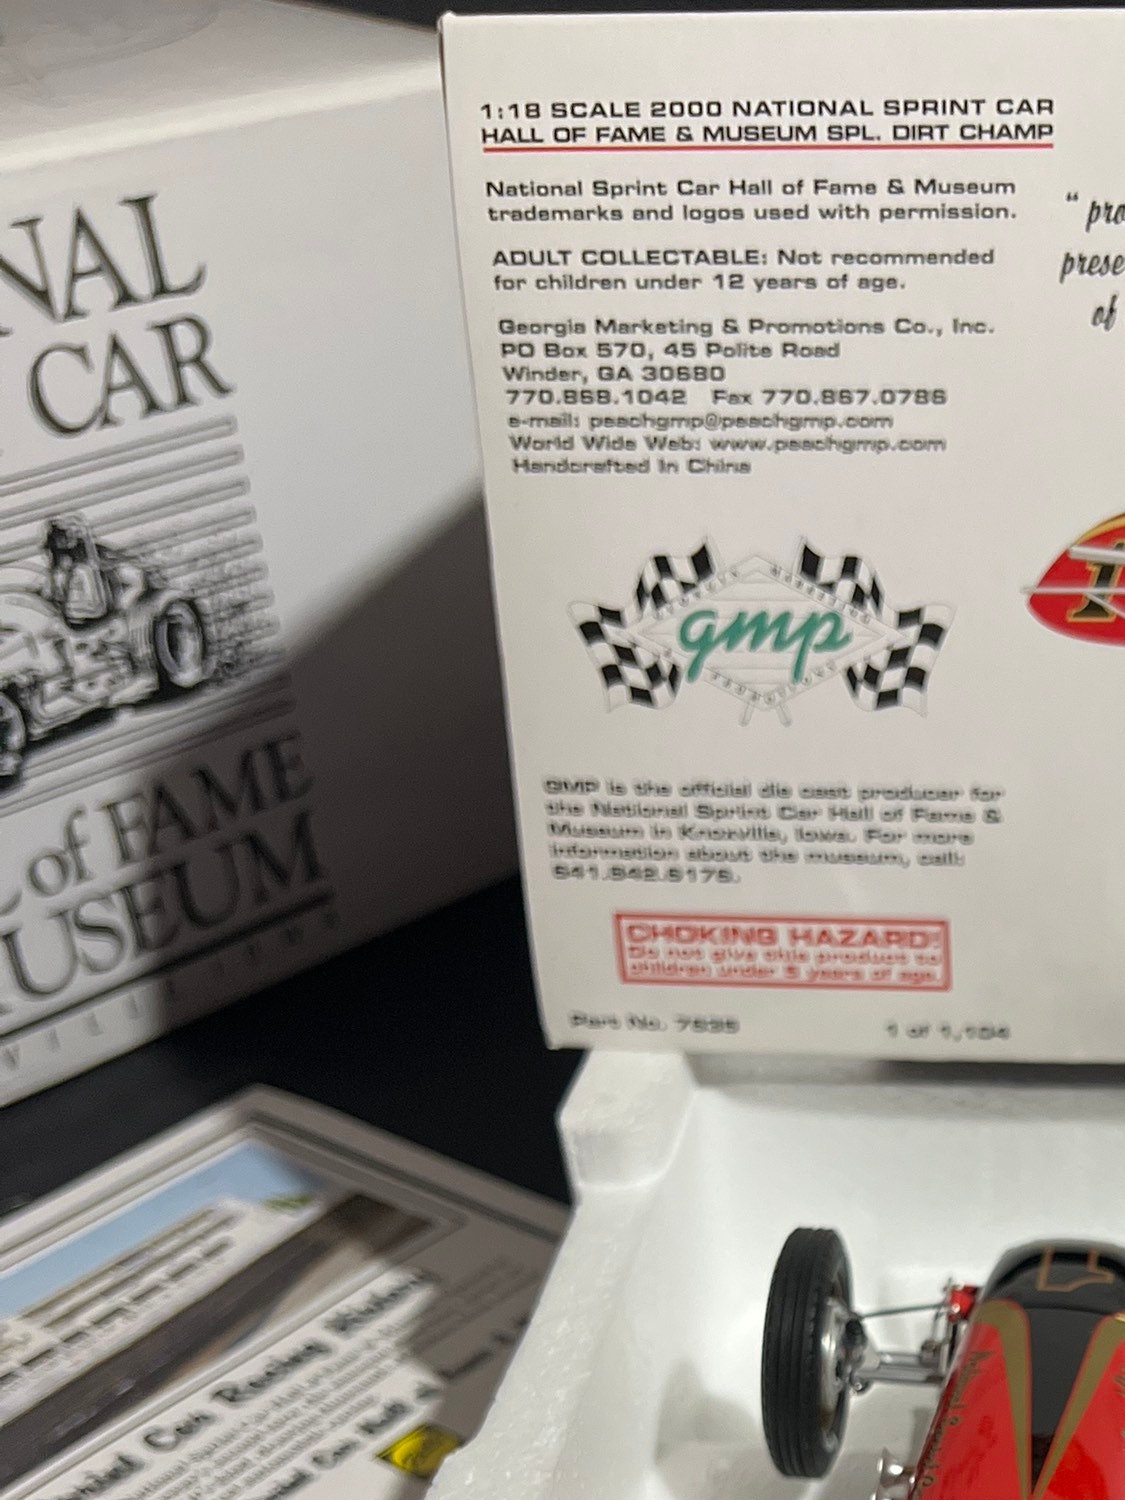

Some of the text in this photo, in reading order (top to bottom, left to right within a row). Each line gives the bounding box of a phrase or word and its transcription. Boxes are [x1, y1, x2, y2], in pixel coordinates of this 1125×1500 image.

[480, 98, 1055, 121] 1:18 SCALE 2000 NATIONAL SPRINT CAR
[480, 122, 1055, 146] HALL OF FAME & MUSEUM SPL. DIRT CHAMP
[484, 175, 1017, 204] National Sprint Car Hall of Fame & Museum
[487, 198, 1017, 226] trademarks and logos used with permission.
[491, 243, 996, 268] ADULT COLLECTABLE: Not recommended
[492, 269, 906, 295] for children under 12 years of age.
[1090, 293, 1120, 331] of
[497, 315, 994, 340] Georgia Marketing & Promotions Co., Inc.
[499, 340, 841, 362] PO Box 570, 45 Polite Road
[28, 315, 237, 438] CAR
[501, 364, 589, 387] Winder,
[595, 364, 634, 387] GA
[710, 387, 753, 405] Fax
[507, 411, 580, 429] e-mail:
[508, 432, 576, 452] World
[580, 432, 638, 452] Wide
[642, 432, 702, 452] Web:
[511, 456, 651, 475] Handcrafted
[685, 456, 752, 474] China
[679, 608, 851, 685] gmp
[27, 733, 316, 897] of FAME
[0, 808, 323, 998] USEUM
